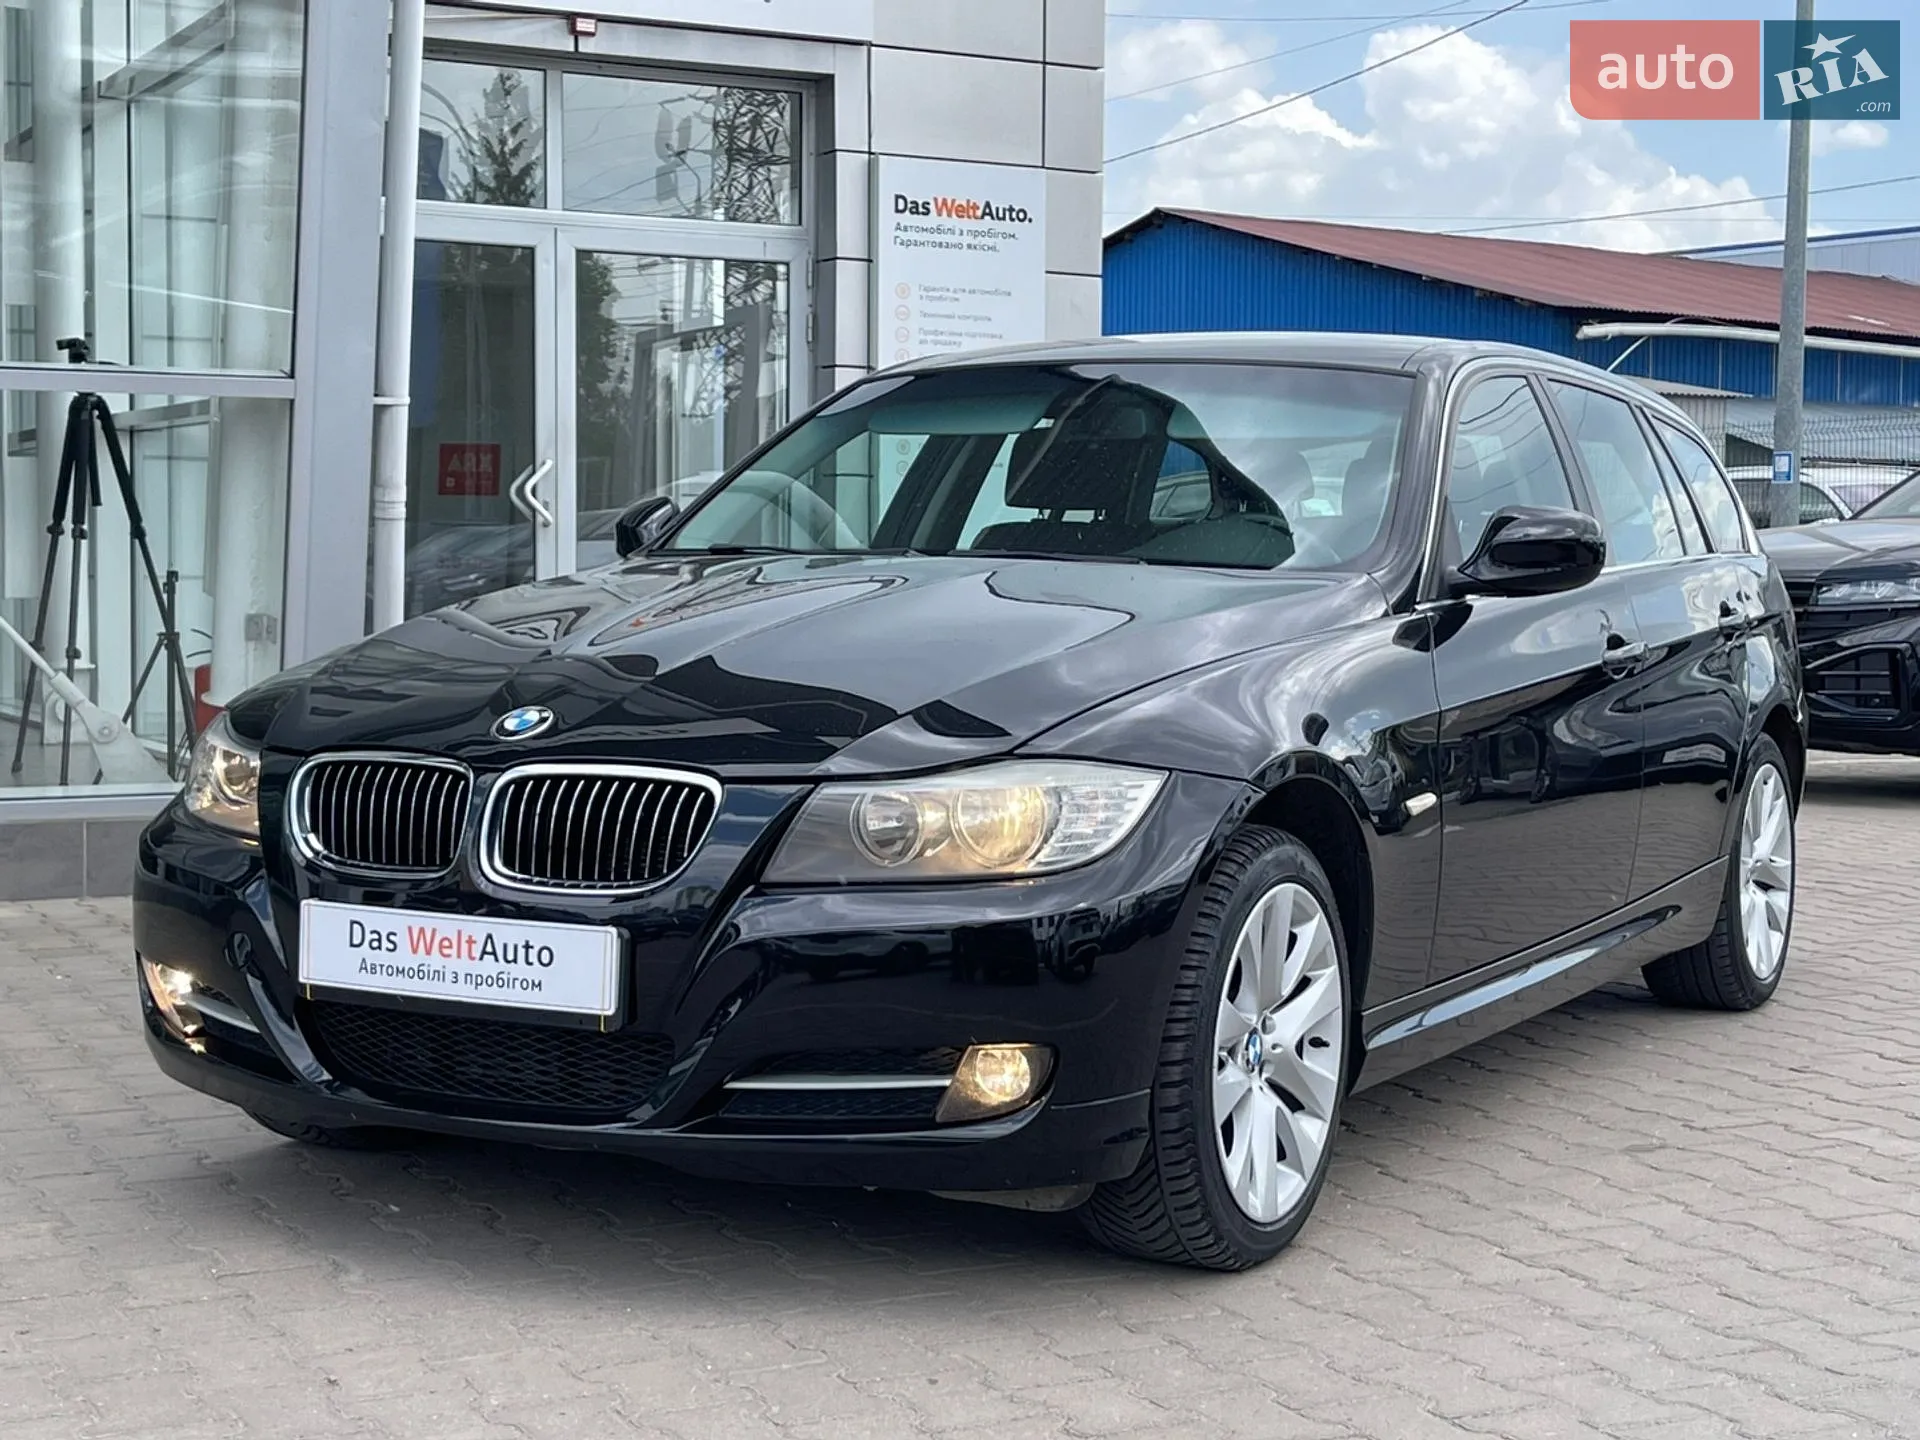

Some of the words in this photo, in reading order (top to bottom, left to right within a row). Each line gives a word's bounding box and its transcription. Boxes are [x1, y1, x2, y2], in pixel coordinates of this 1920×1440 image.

[894, 193, 931, 216] Das
[933, 196, 1033, 223] WeltAuto.
[893, 236, 964, 249] Гарантовано
[966, 242, 1000, 252] якісні.
[894, 222, 955, 236] Автомобілі
[958, 228, 964, 237] з
[966, 227, 1019, 240] пробігом.
[349, 919, 398, 952] Das
[407, 925, 555, 967] WeltAuto
[358, 957, 446, 983] Автомобілі
[451, 971, 459, 985] з
[464, 972, 543, 993] пробігом
